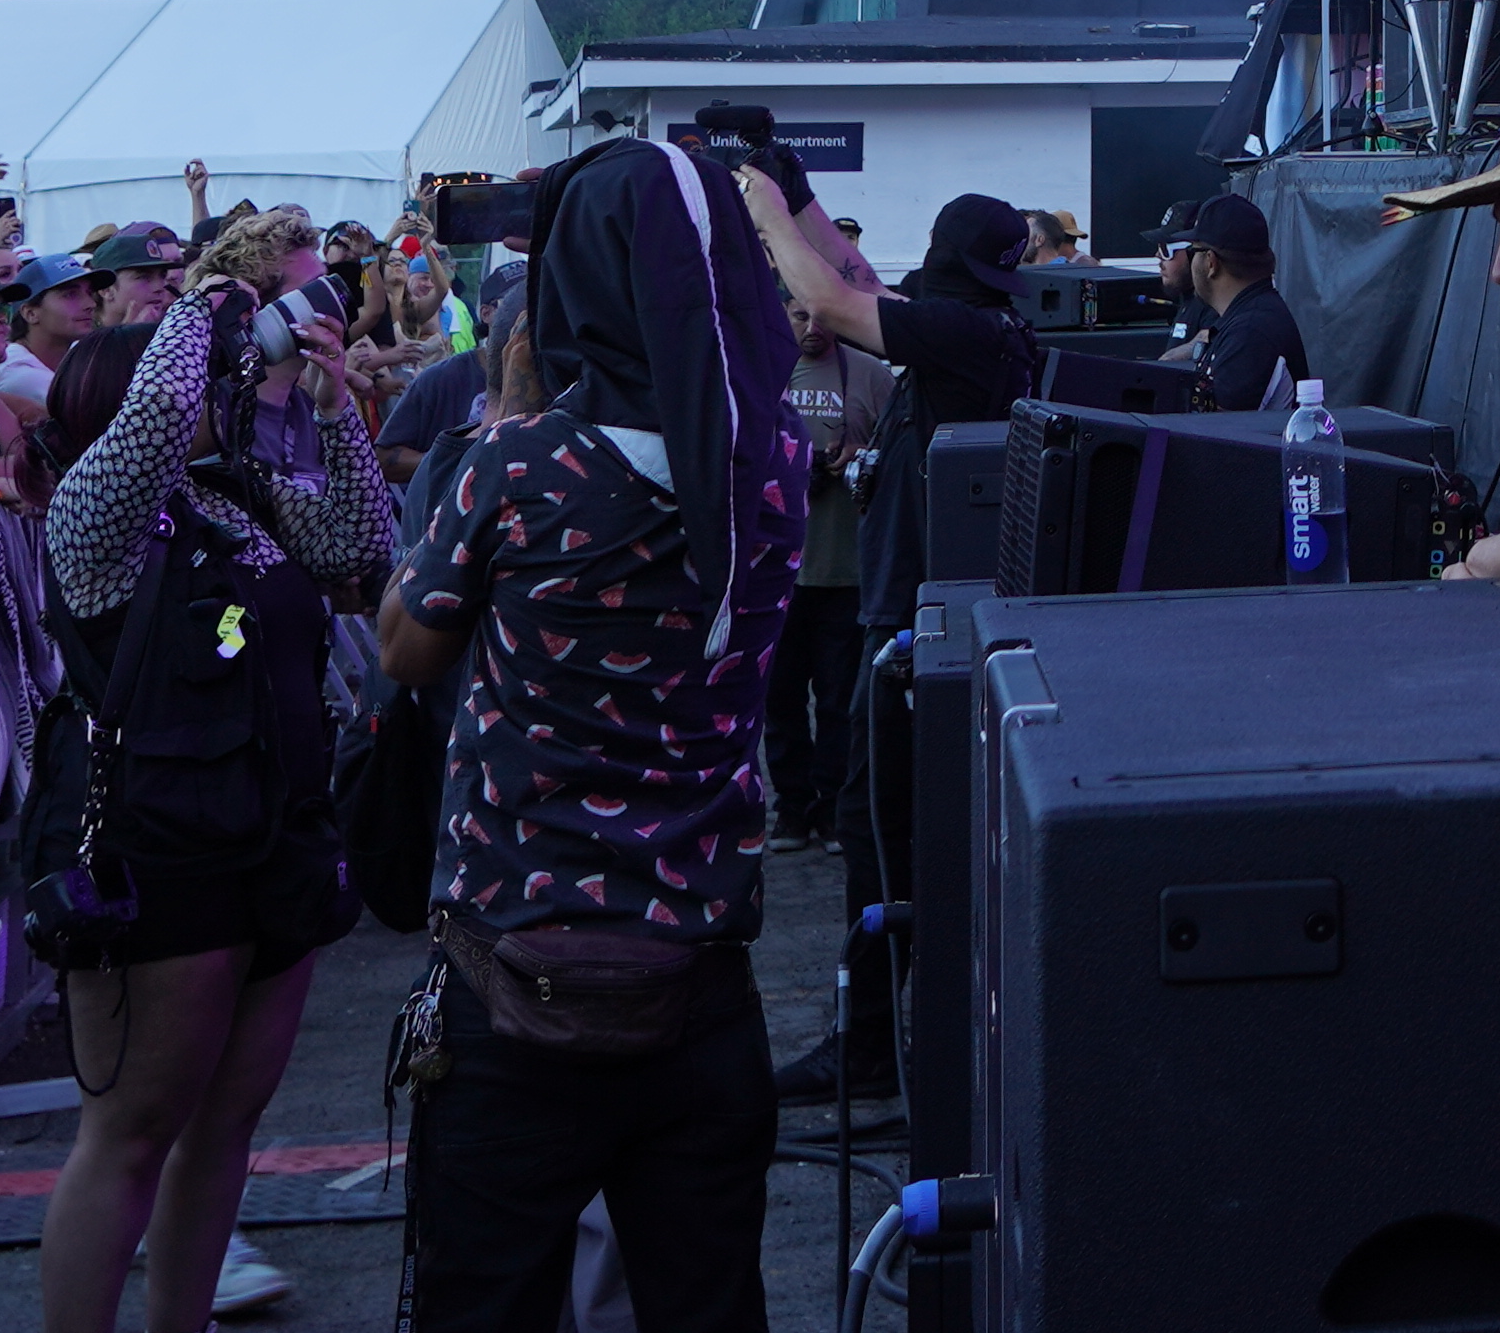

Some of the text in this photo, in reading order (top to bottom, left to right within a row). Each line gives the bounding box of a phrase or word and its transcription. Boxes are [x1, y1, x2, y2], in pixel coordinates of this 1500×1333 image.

[789, 389, 844, 408] REEN
[1308, 475, 1321, 513] water
[1288, 475, 1311, 559] smart
